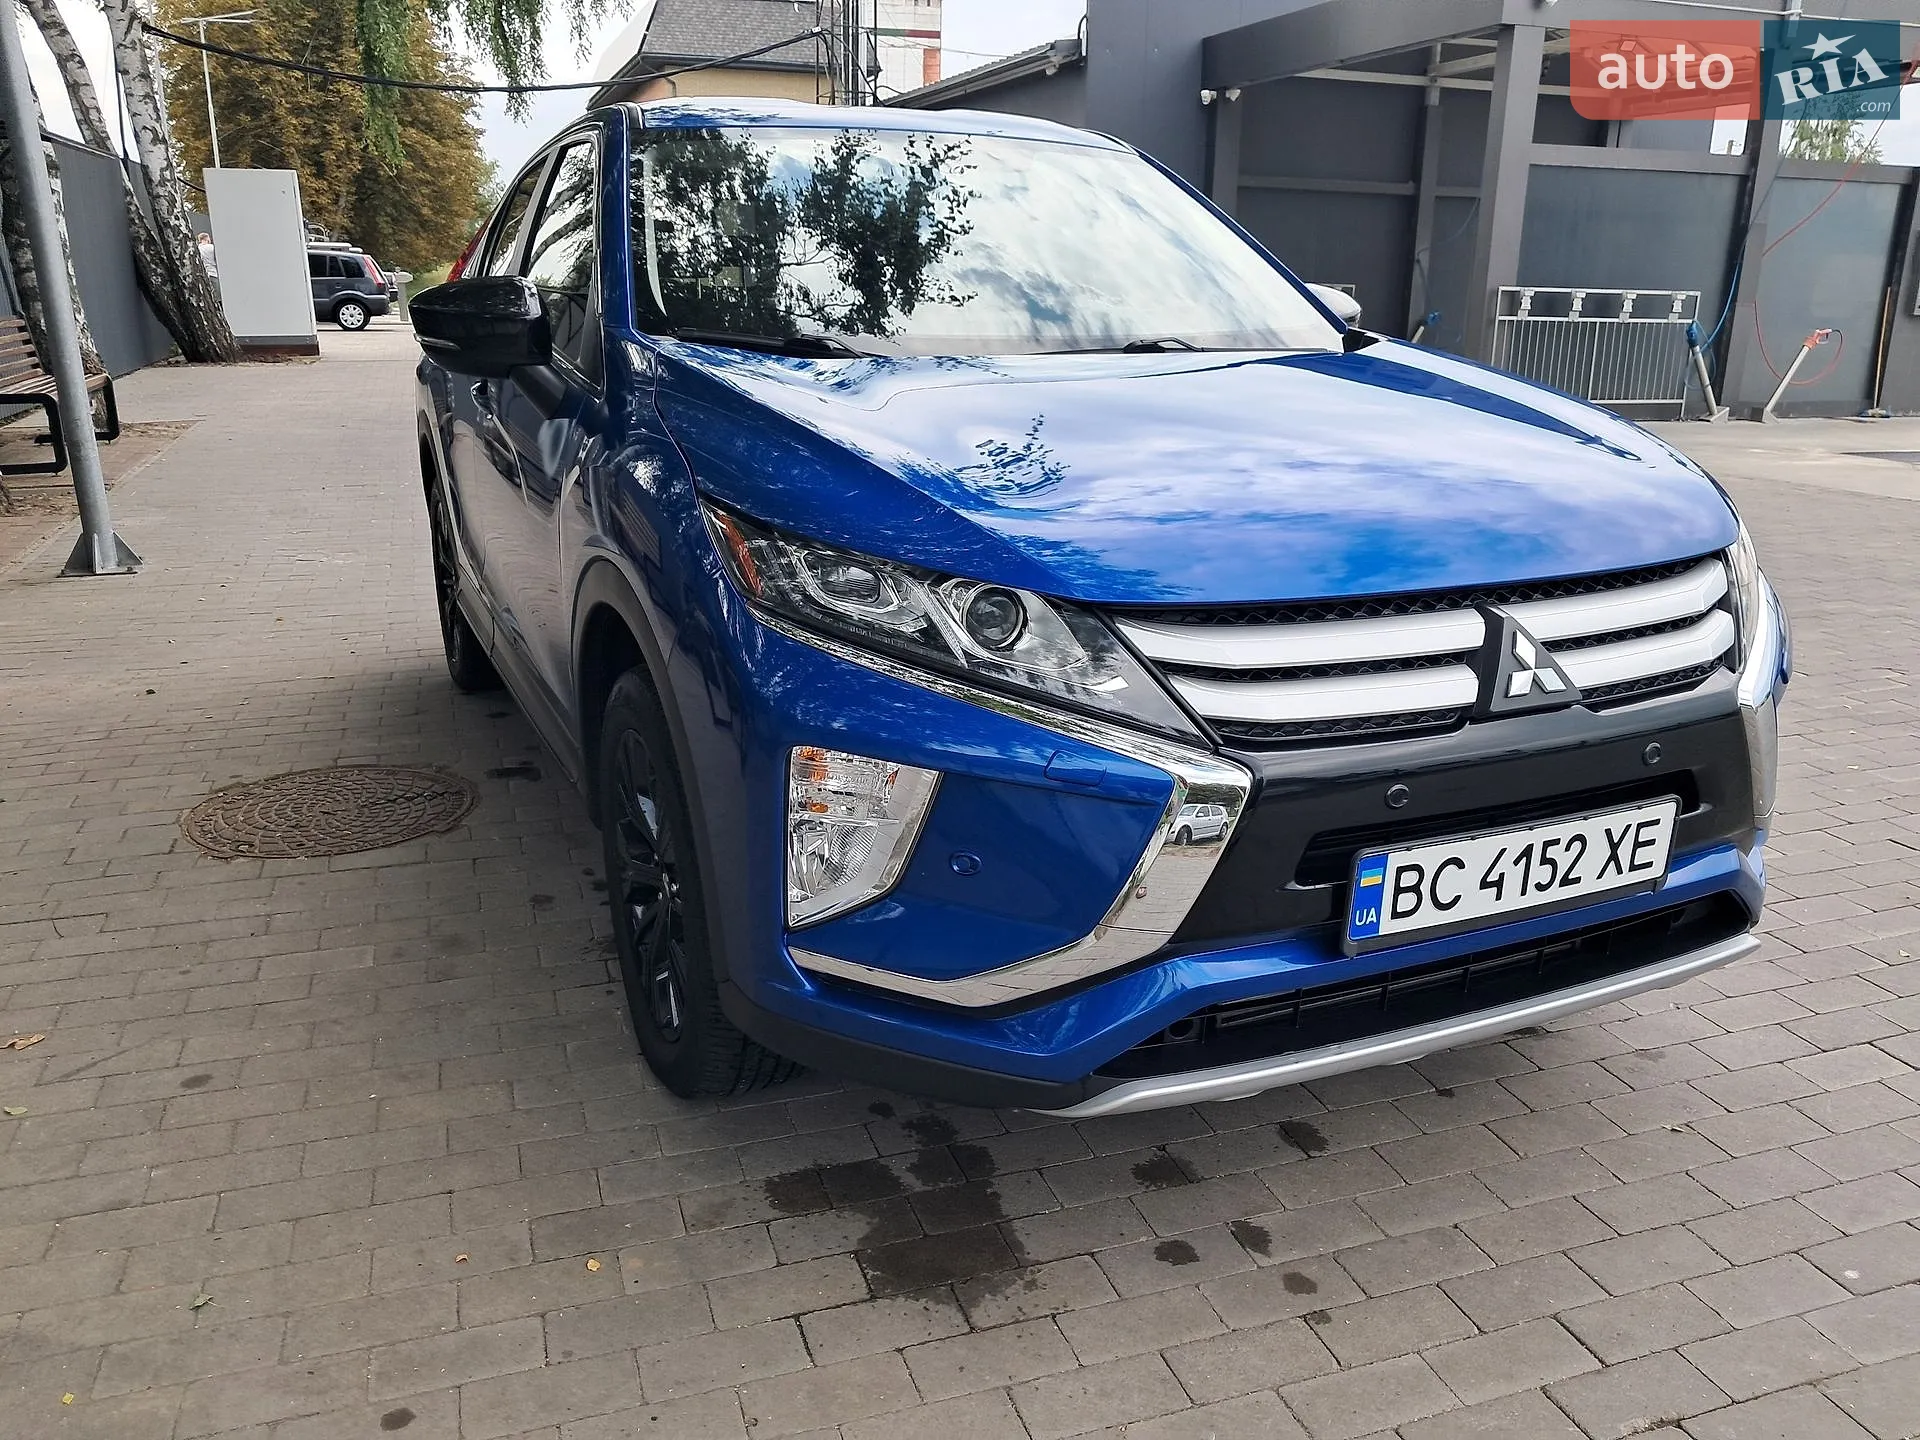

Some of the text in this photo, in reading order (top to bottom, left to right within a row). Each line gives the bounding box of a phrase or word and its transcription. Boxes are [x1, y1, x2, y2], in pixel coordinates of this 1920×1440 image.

[1390, 818, 1661, 920] BC 4152 XE
[1355, 908, 1377, 926] UA
